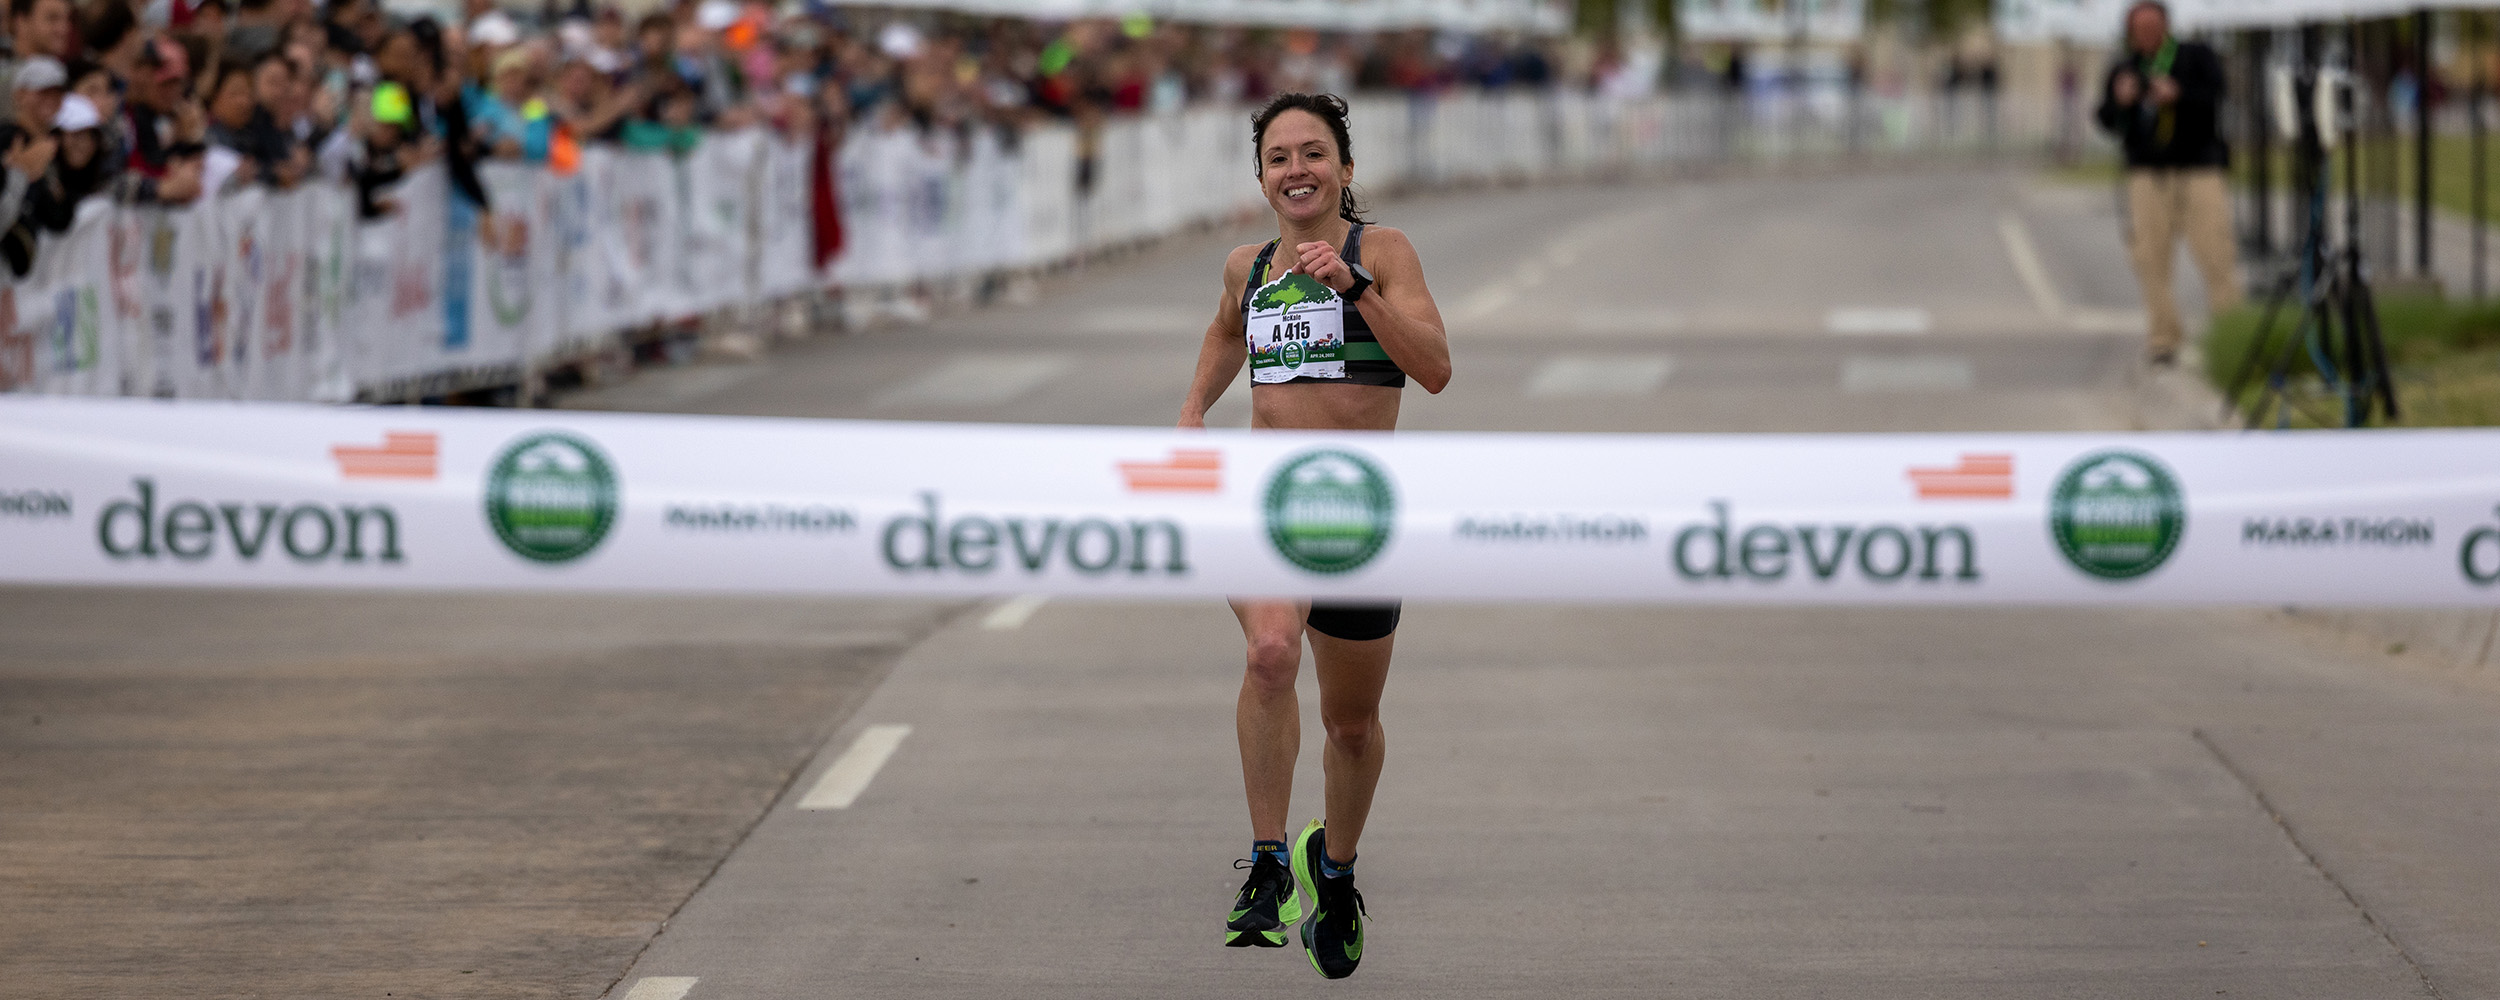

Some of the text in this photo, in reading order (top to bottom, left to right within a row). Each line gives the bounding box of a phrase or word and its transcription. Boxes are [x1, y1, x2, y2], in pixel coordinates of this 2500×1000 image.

[1272, 321, 1310, 342] A 415
[97, 475, 405, 564] devon
[880, 492, 1190, 577] devon
[1672, 501, 1981, 584] devon
[2242, 516, 2435, 545] MARATHON
